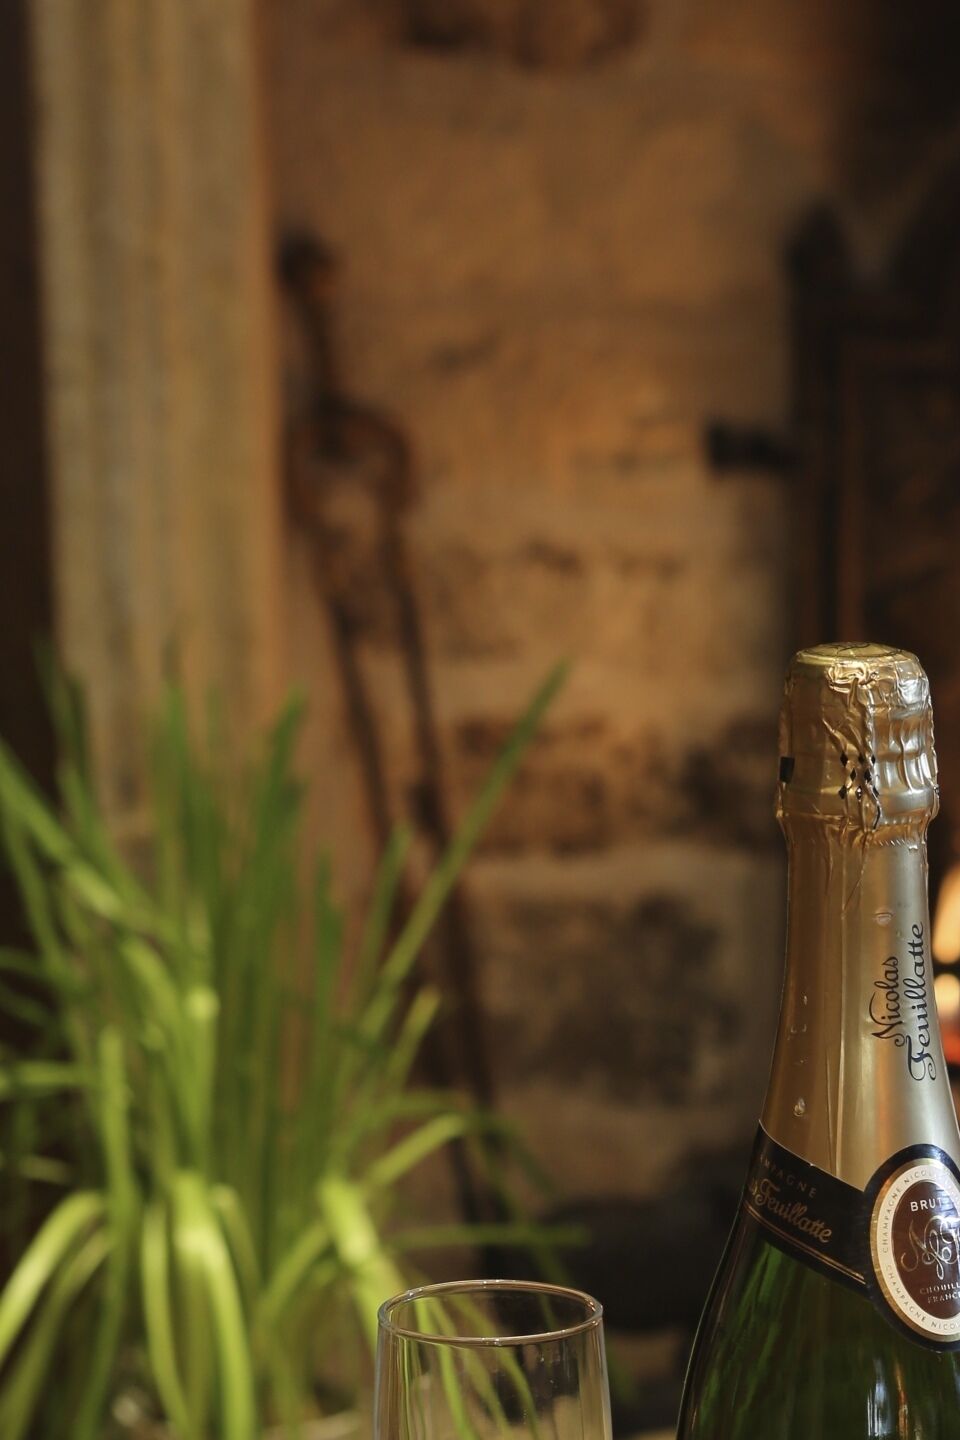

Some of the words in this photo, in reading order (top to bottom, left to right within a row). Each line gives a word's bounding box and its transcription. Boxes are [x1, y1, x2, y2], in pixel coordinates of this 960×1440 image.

[868, 956, 906, 1047] Nicolas
[903, 921, 937, 1081] Feuillatte
[754, 1178, 833, 1243] Feuillatte
[909, 1197, 945, 1212] BRUT
